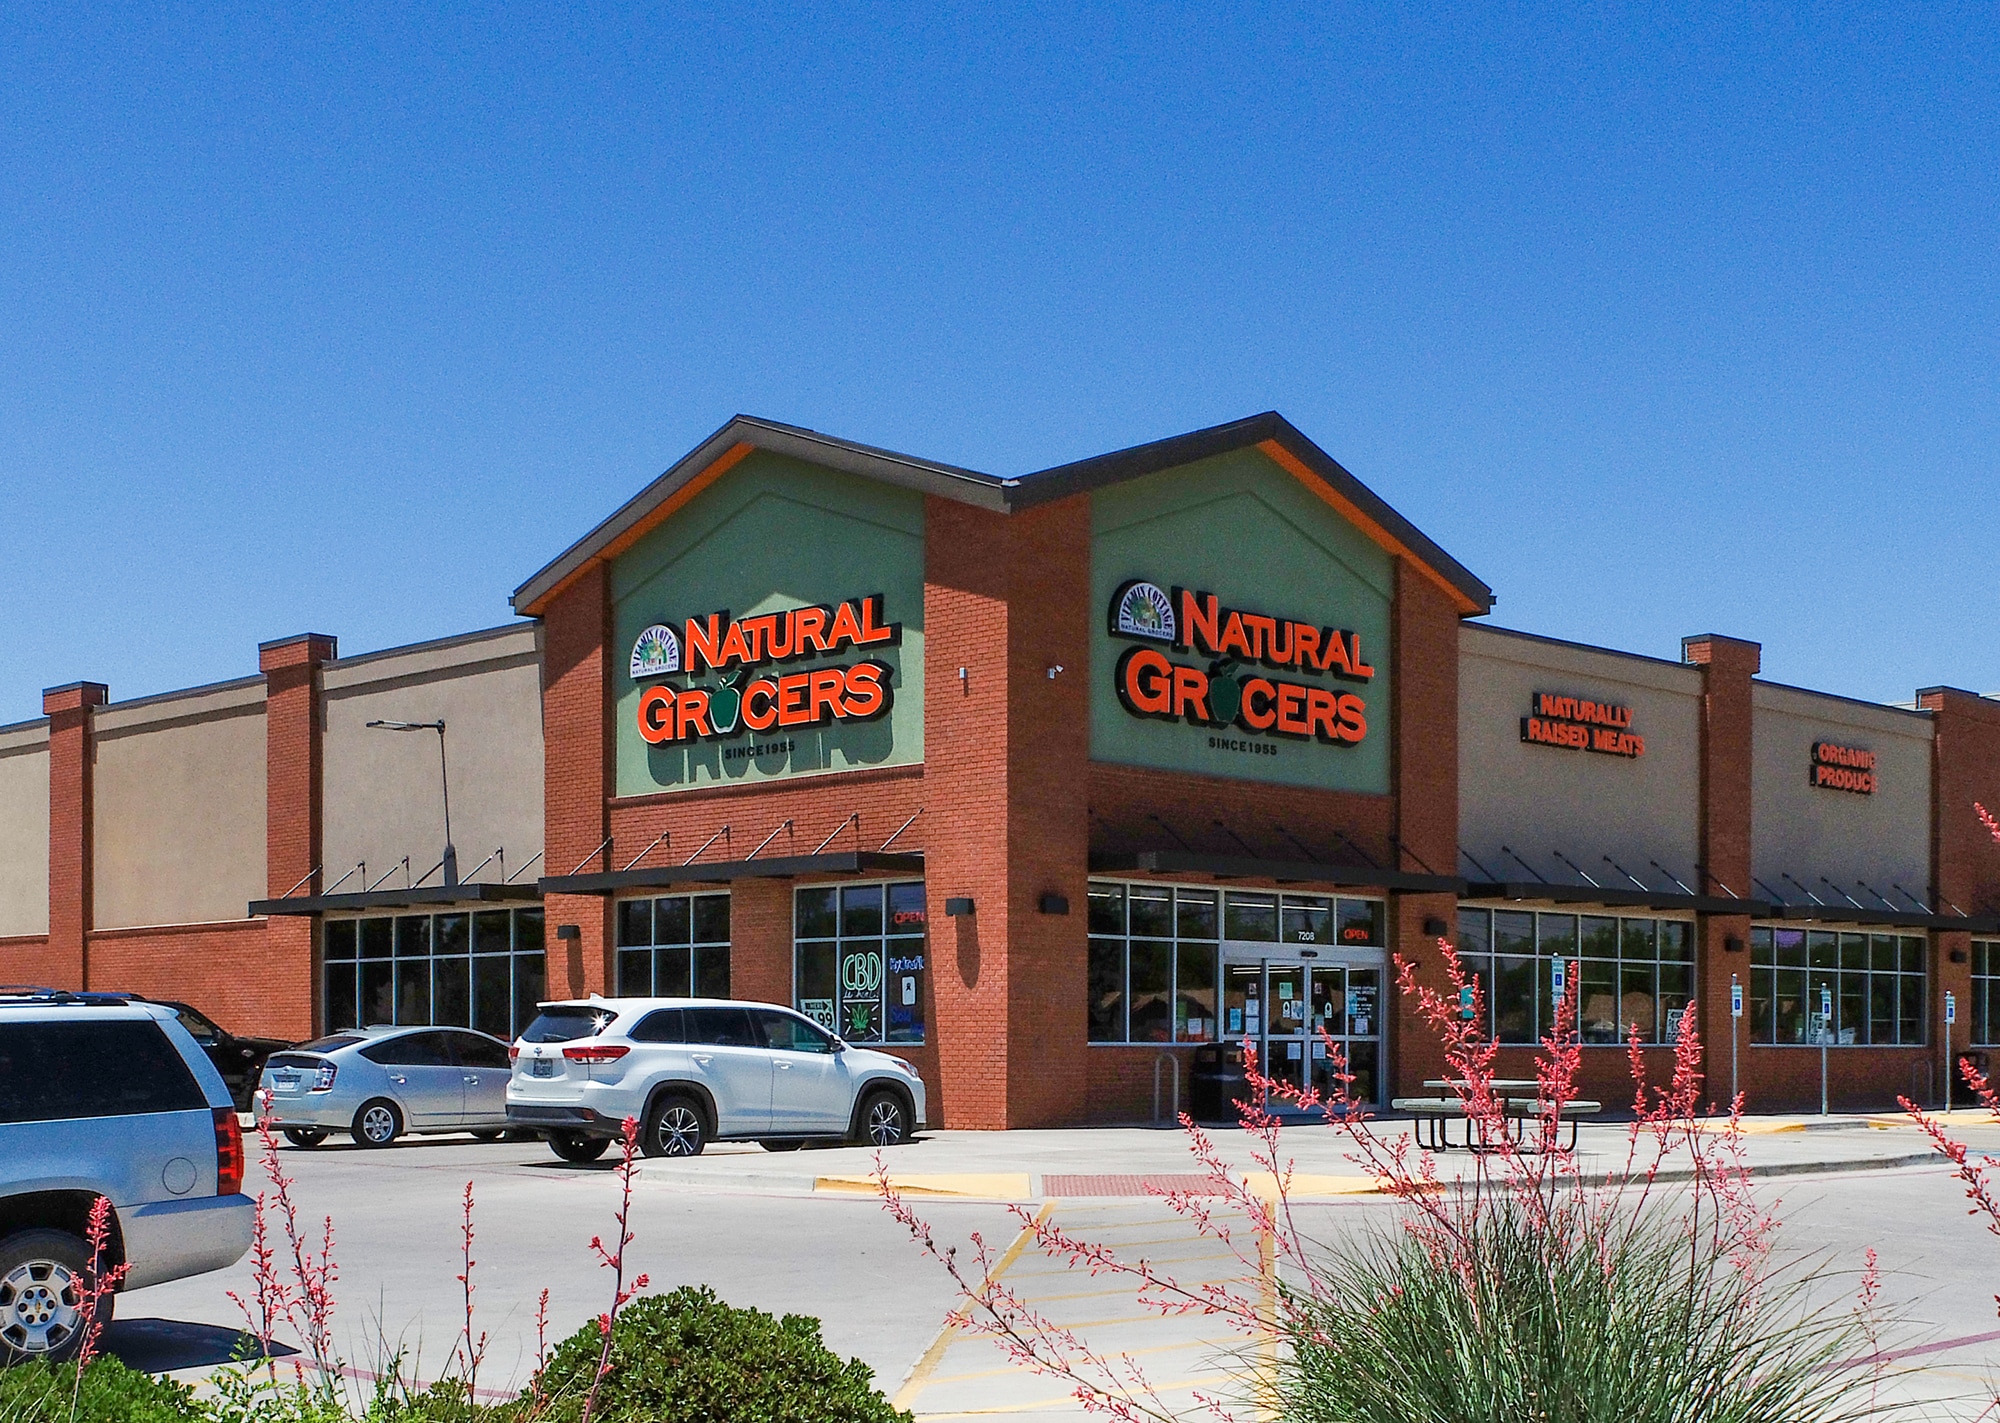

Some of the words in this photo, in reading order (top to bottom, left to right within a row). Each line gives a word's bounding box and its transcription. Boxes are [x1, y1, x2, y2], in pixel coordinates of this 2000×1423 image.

[1121, 586, 1146, 621] VITAMIN
[1148, 587, 1173, 629] COTTAGE
[684, 597, 891, 673] NATURAL
[1182, 590, 1375, 678] NATURAL
[1541, 694, 1633, 728] NATURALLY
[1529, 718, 1589, 748] RAISED
[1593, 729, 1645, 756] MEATS
[1818, 743, 1875, 769] ORGANIC
[1817, 765, 1877, 793] PRODUCE
[894, 911, 924, 924] OPEN
[1344, 929, 1369, 940] OPEN
[842, 952, 882, 991] CBD
